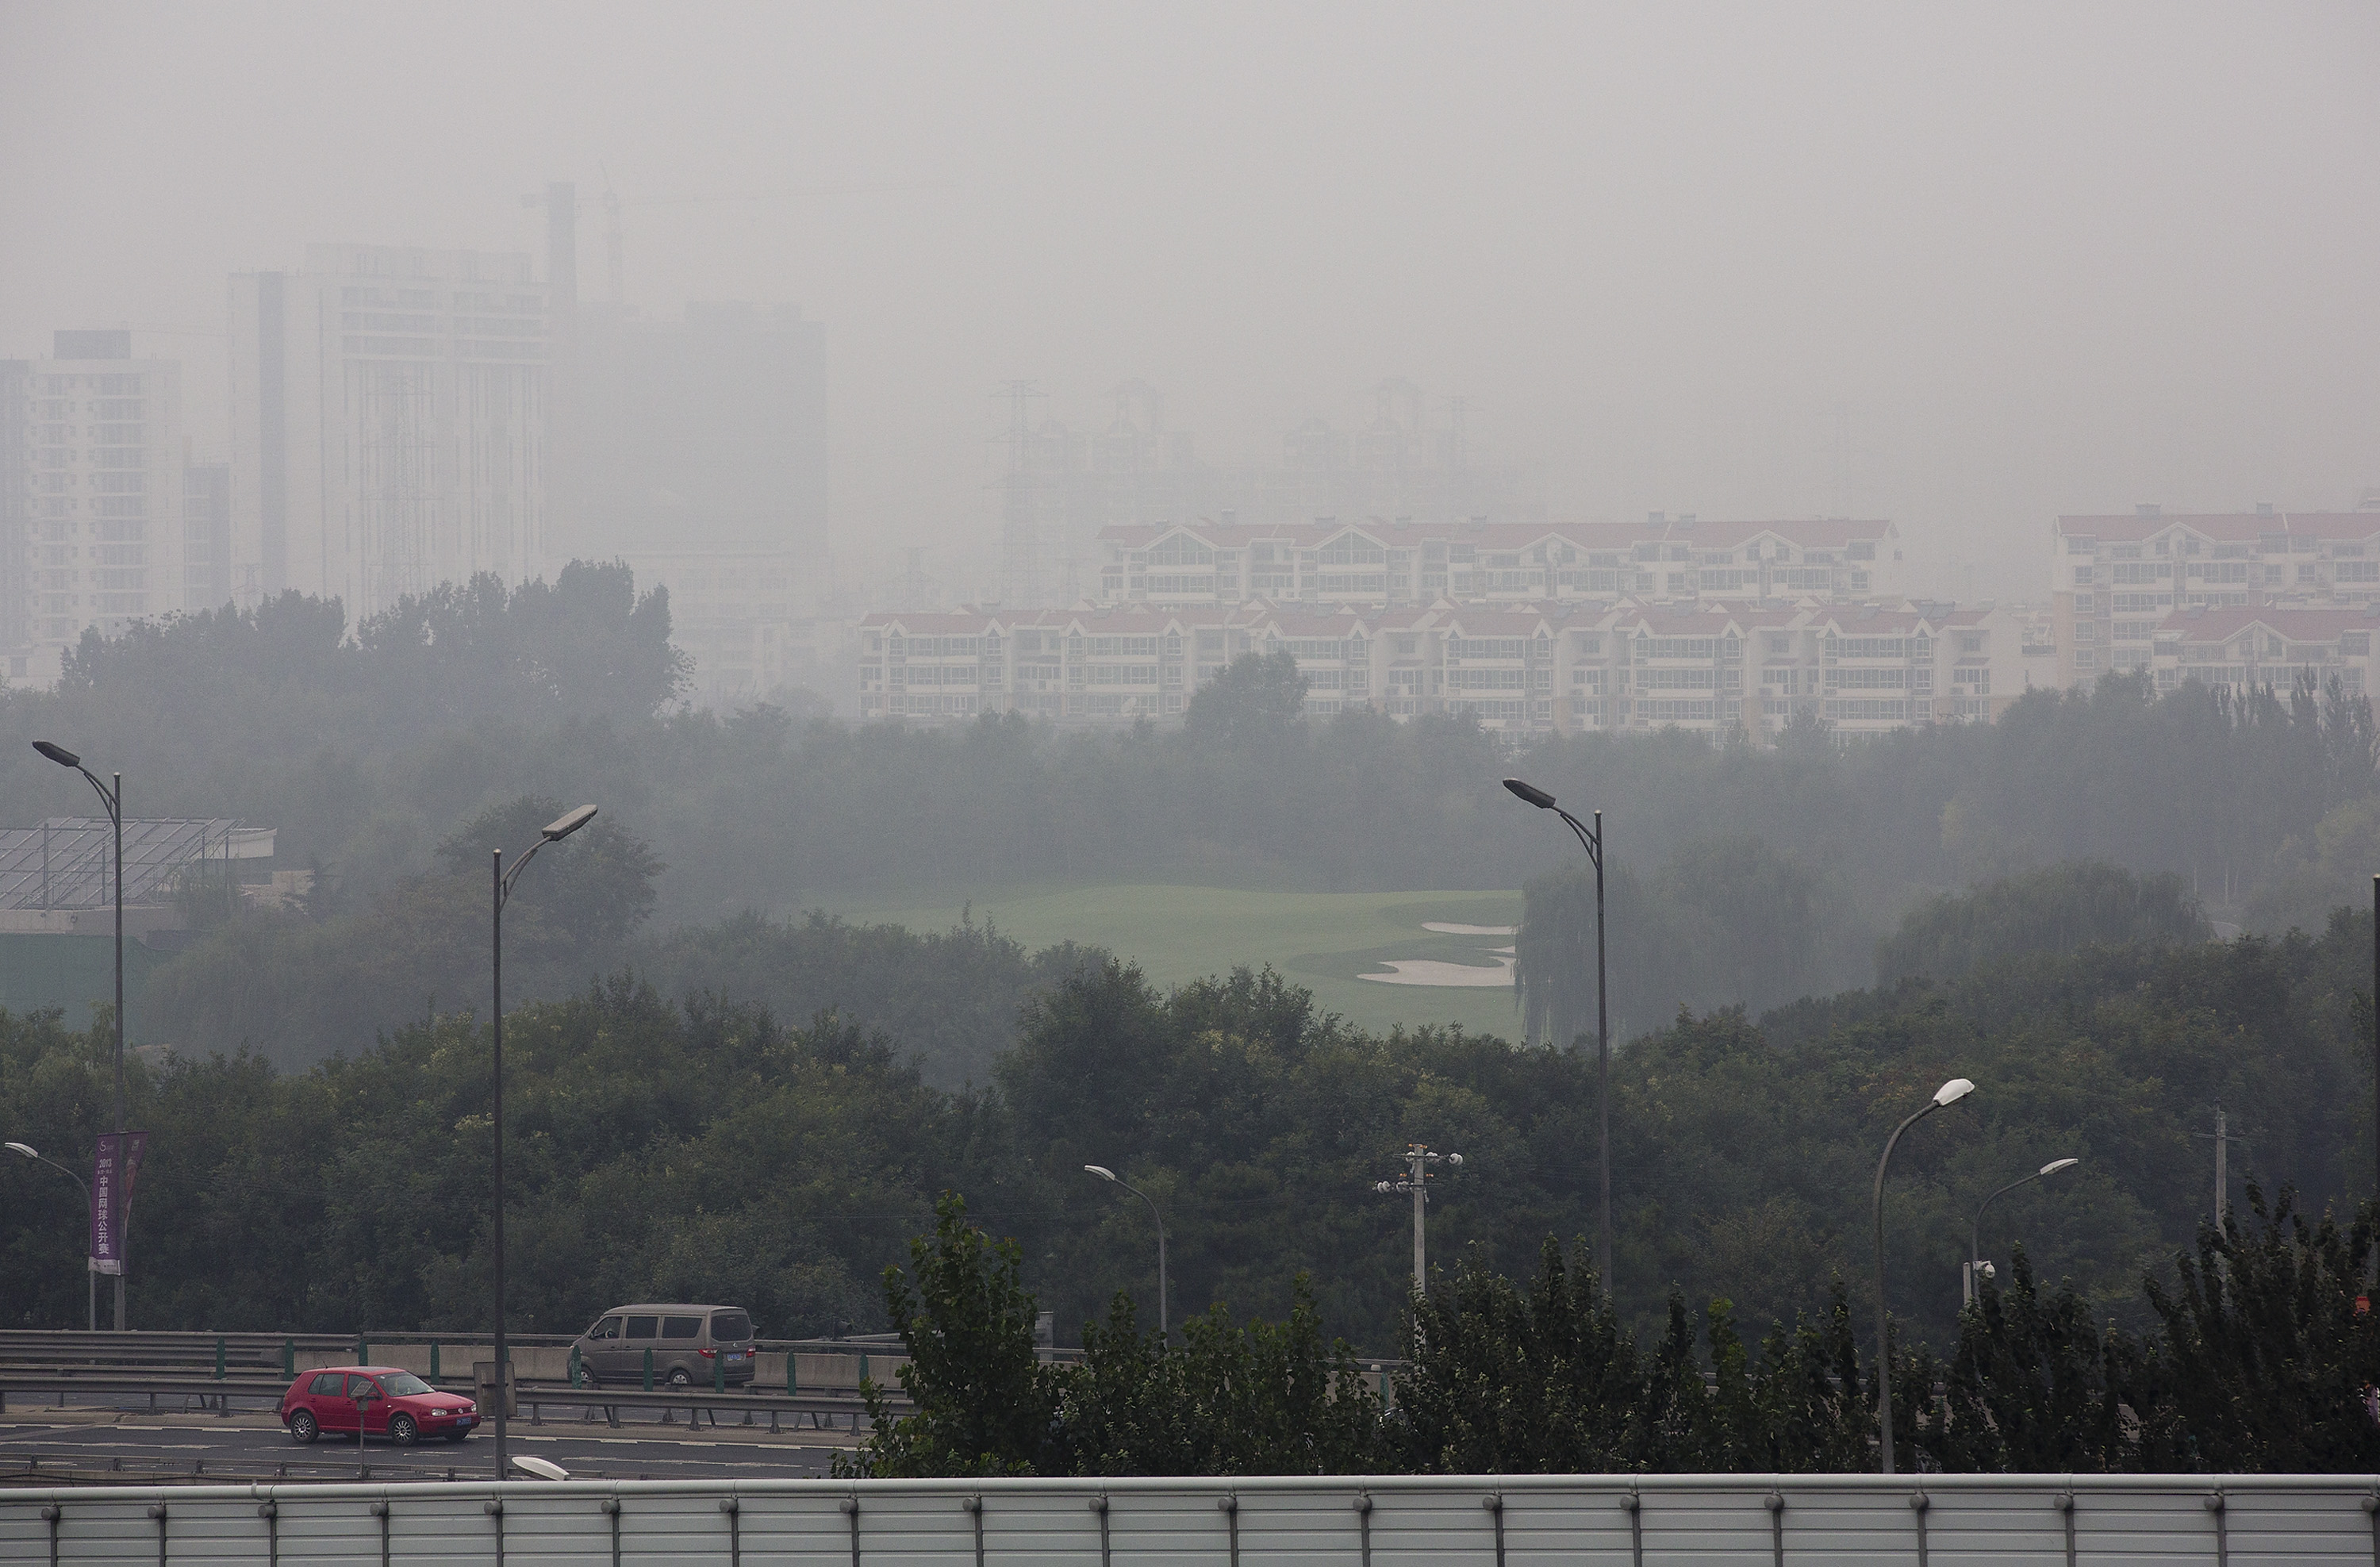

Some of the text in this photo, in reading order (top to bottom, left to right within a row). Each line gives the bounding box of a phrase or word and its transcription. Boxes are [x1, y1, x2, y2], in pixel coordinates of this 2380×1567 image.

[99, 1158, 112, 1168] 2013
[98, 1176, 109, 1254] 中国网球公开赛
